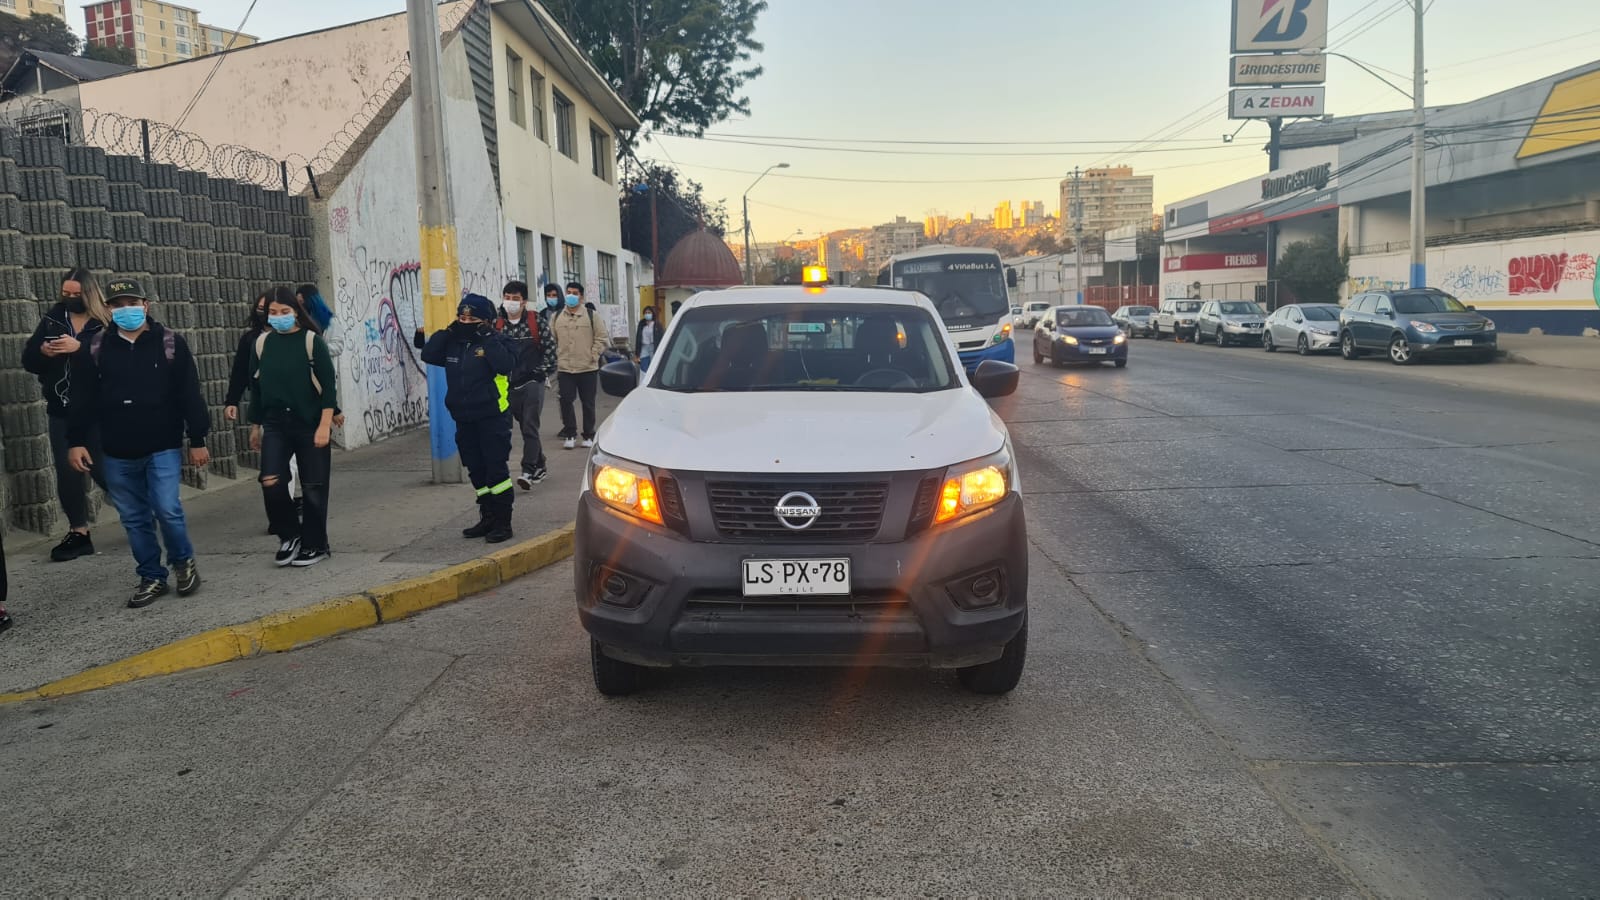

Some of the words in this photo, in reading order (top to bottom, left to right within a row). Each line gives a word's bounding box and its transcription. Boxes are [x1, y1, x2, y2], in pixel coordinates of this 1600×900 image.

[1238, 63, 1321, 76] BRIDGESTONE
[1243, 96, 1255, 109] A
[1258, 95, 1315, 109] ZEDAN
[1224, 254, 1258, 267] FRENOS
